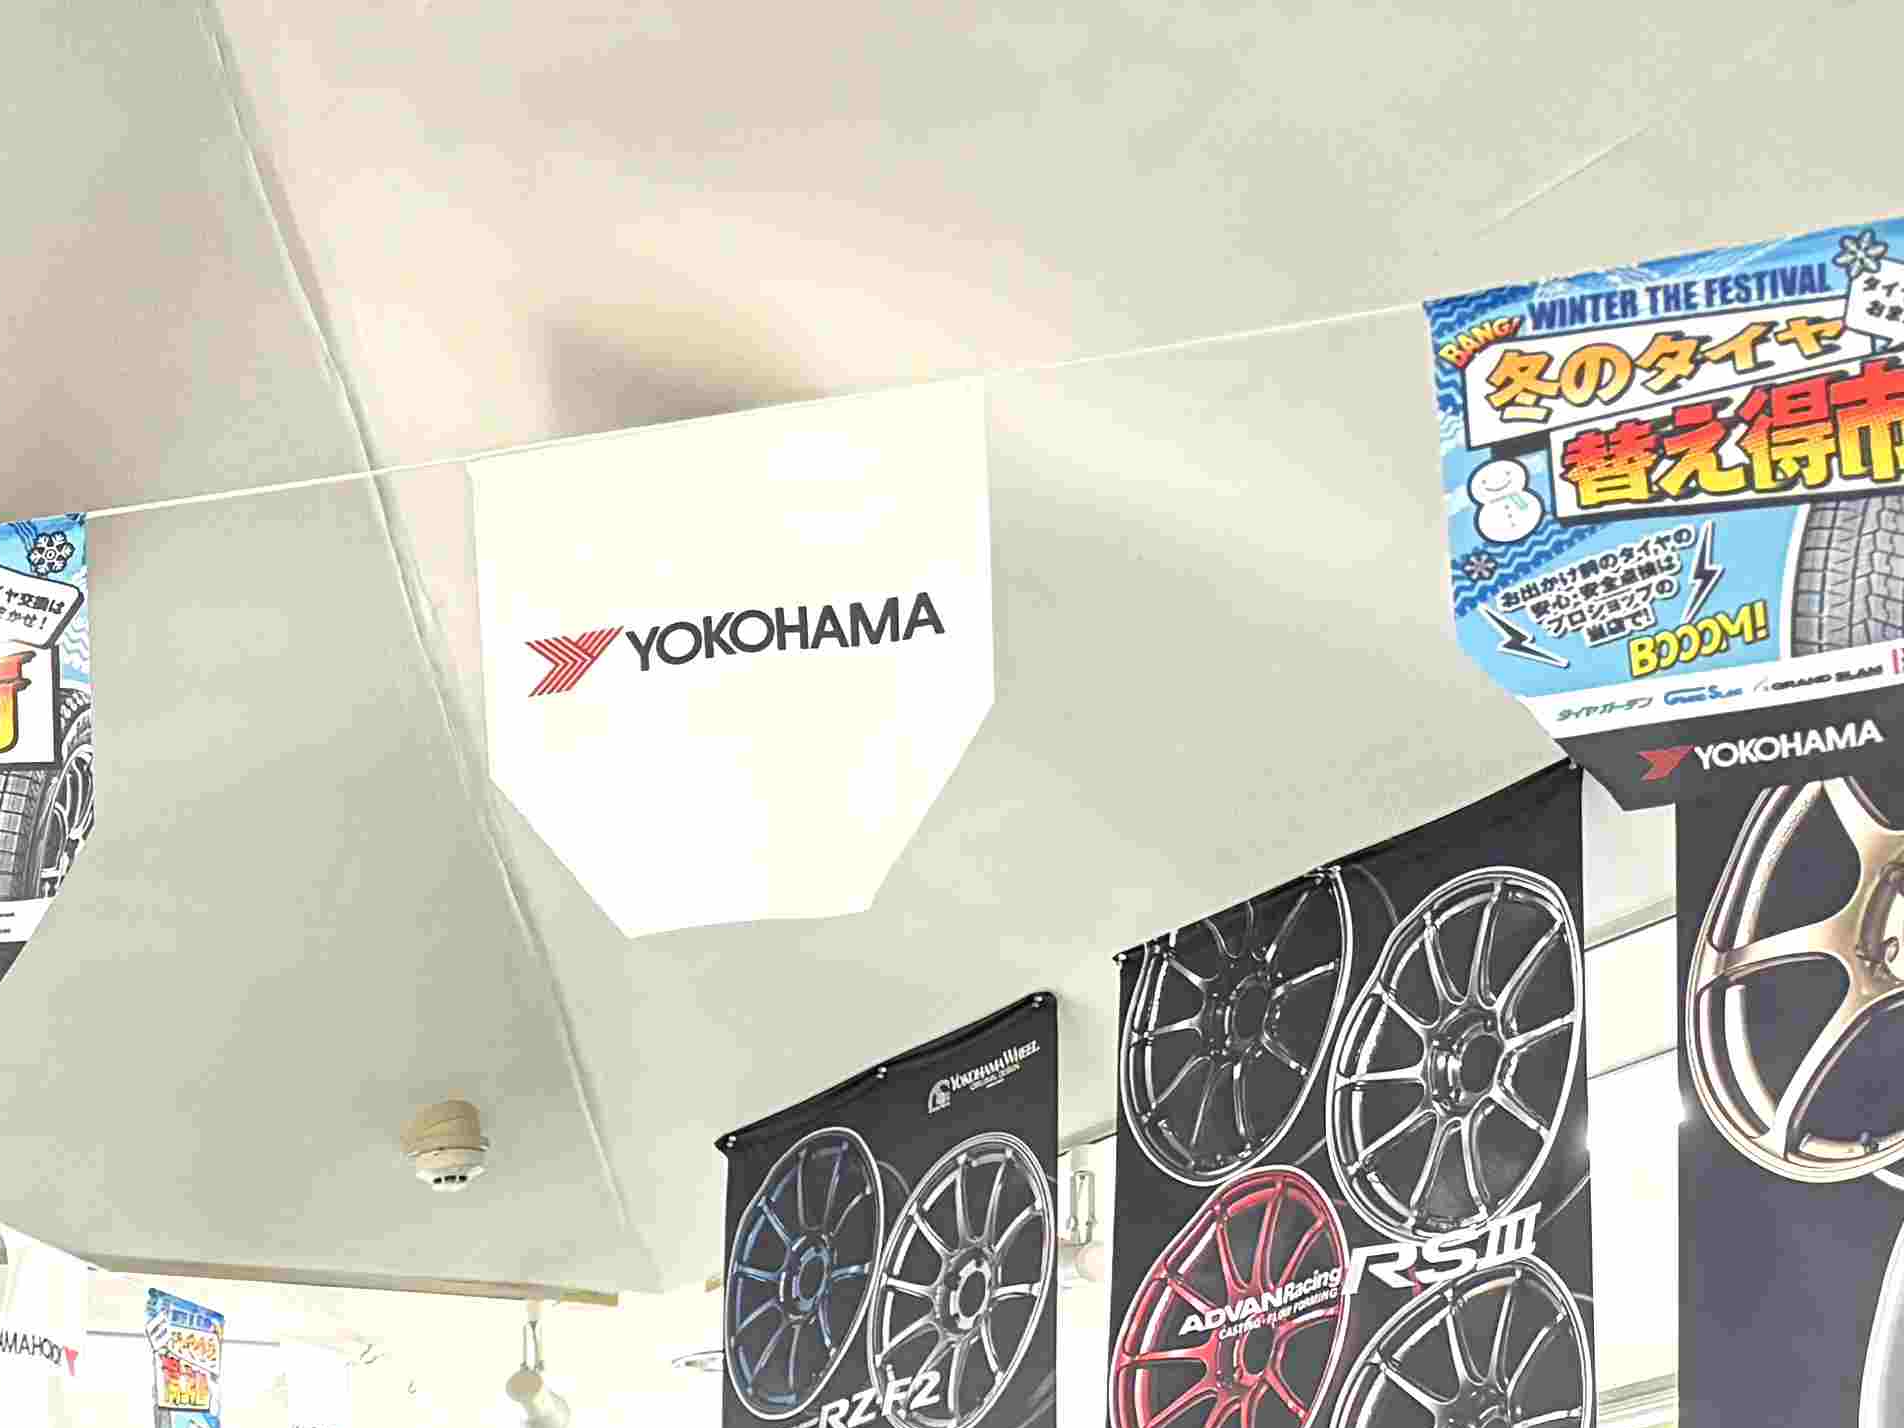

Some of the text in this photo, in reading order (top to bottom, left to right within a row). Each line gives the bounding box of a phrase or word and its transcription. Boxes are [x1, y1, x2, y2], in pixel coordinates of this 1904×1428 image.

[1527, 291, 1640, 331] WINTER
[1646, 280, 1699, 316] THE
[1703, 263, 1831, 308] FESTIVAL
[1439, 316, 1523, 368] BANG!
[1485, 316, 1847, 424] 冬のタイヤ
[1561, 357, 1904, 508] 替え得市
[626, 589, 946, 678] YOKOHAMA
[1629, 600, 1768, 678] BOOOM!
[1695, 719, 1884, 771] YOKOHAMA
[1177, 1284, 1288, 1336] ADVAN
[1283, 1267, 1342, 1303] Racing
